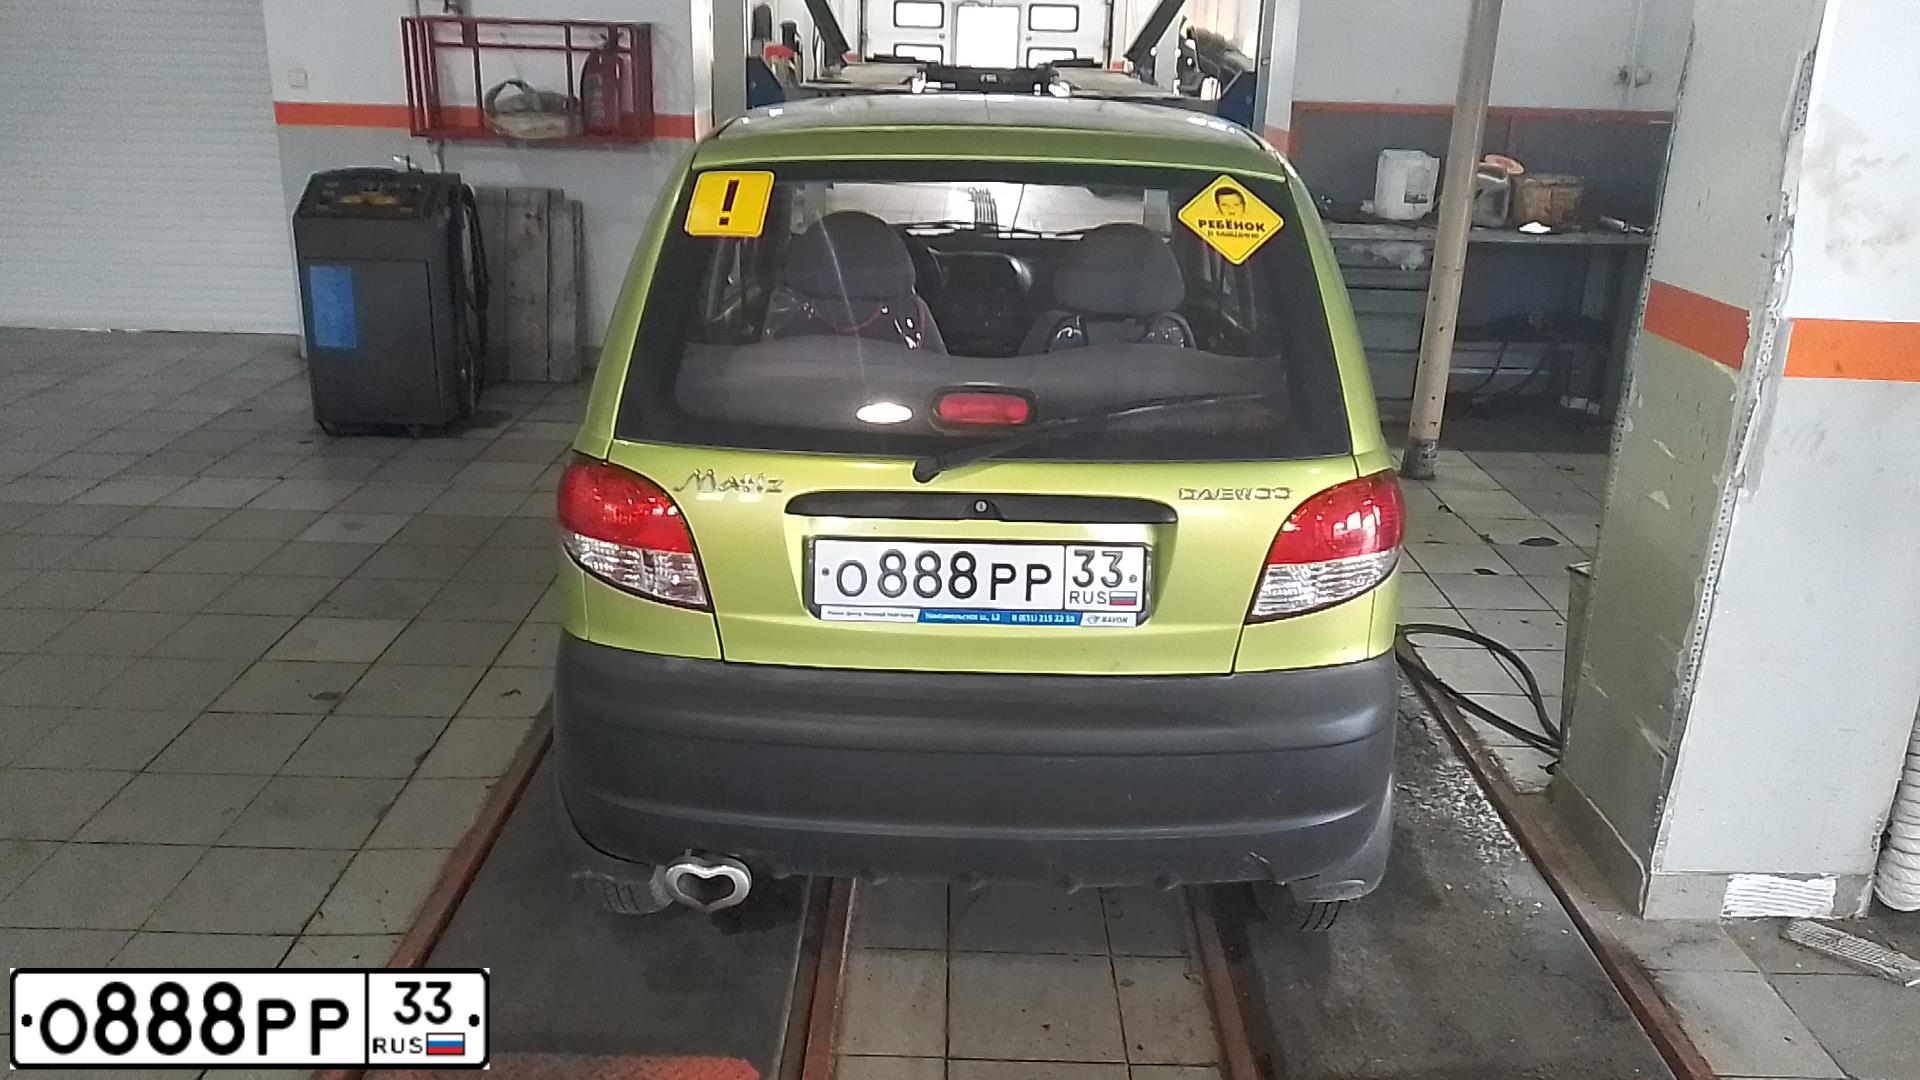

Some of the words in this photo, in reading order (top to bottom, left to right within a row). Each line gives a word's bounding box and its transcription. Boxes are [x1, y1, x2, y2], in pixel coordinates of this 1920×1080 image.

[1197, 218, 1266, 233] РЕБЁНОК
[1178, 486, 1293, 501] DAEWOO
[1072, 549, 1124, 588] 33
[1069, 591, 1107, 605] RUS
